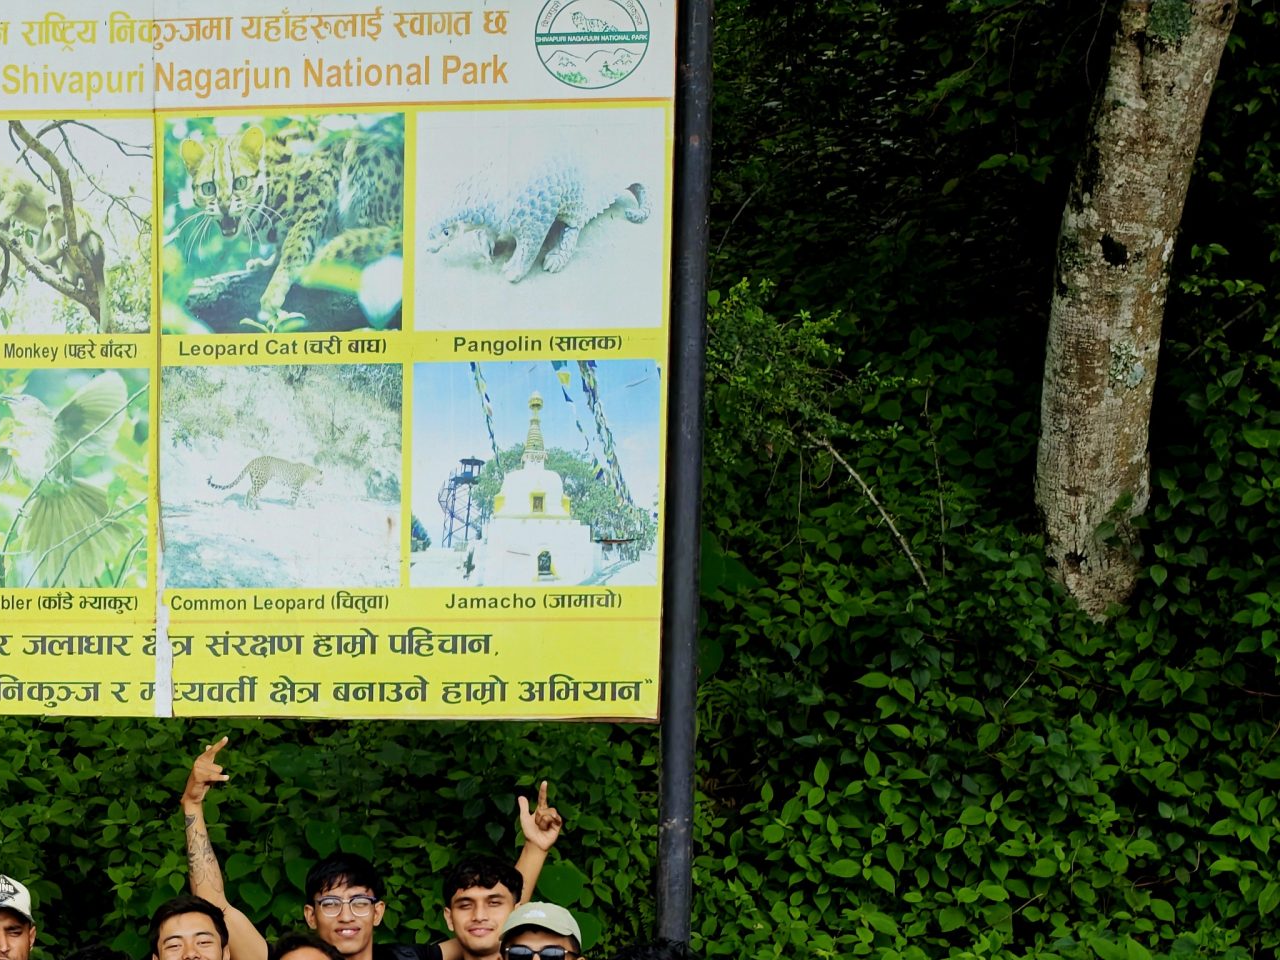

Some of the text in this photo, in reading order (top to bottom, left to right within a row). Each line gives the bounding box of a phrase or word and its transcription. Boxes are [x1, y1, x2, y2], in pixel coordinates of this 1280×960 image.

[21, 11, 99, 52] राष्ट्रिय
[109, 10, 233, 51] निकुञ्जमा
[394, 11, 472, 38] स्वागत
[483, 11, 509, 36] छ
[2, 63, 145, 101] Shivapuri
[155, 60, 290, 99] Nagarjun
[304, 57, 430, 88] National
[442, 54, 508, 85] Park
[4, 343, 58, 362] Monkey
[179, 340, 258, 359] Leopard
[265, 339, 298, 356] Cat
[454, 335, 622, 355] Pangolin (सालक)
[170, 595, 247, 610] Common
[253, 594, 325, 613] Leopard
[445, 589, 622, 609] Jamacho (जामाचो)
[22, 635, 133, 656] जलाधार
[206, 631, 304, 658] संरक्षण
[313, 628, 379, 658] हाम्रो
[111, 681, 131, 703] र
[270, 675, 321, 705] क्षेत्र
[332, 675, 429, 703] बनाउने
[441, 675, 508, 706] हाम्रो
